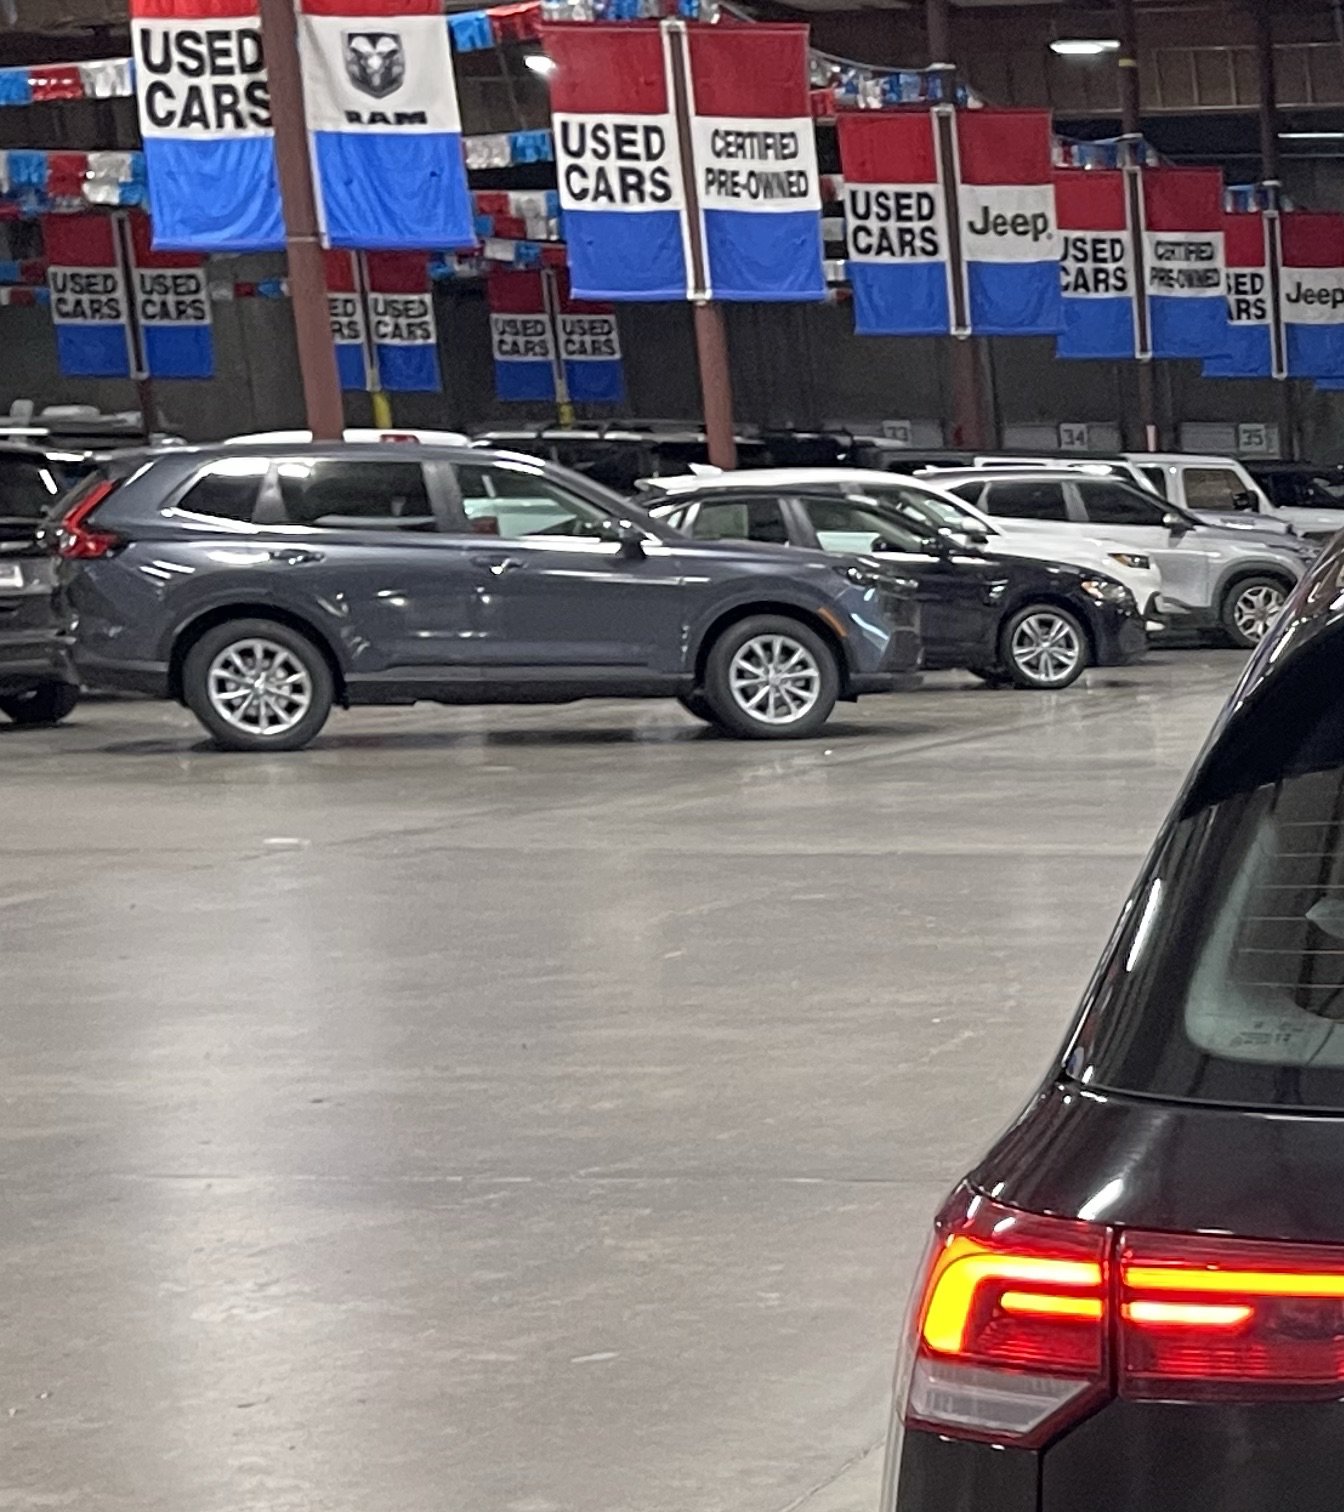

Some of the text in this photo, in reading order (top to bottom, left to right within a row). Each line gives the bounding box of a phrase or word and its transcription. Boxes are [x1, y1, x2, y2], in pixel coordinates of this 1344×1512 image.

[140, 28, 268, 77] USED
[145, 80, 272, 129] CARS
[345, 110, 428, 125] RAM
[561, 121, 665, 161] USED
[711, 128, 798, 160] CERTIFIED
[565, 163, 672, 203] CARS
[704, 167, 808, 199] PRE-OWNED
[850, 190, 935, 222] USED
[967, 206, 1048, 242] Jeep
[852, 225, 939, 257] CARS
[51, 272, 118, 294] USED
[140, 273, 200, 295] USED
[55, 297, 121, 319] CARS
[142, 300, 205, 320] CARS
[374, 298, 428, 318] USED
[375, 320, 431, 340] CARS
[495, 319, 546, 337] USED
[562, 319, 613, 336] USED
[498, 339, 549, 356] CARS
[564, 339, 616, 356] CARS
[1062, 429, 1085, 446] 34
[1242, 428, 1265, 446] 35
